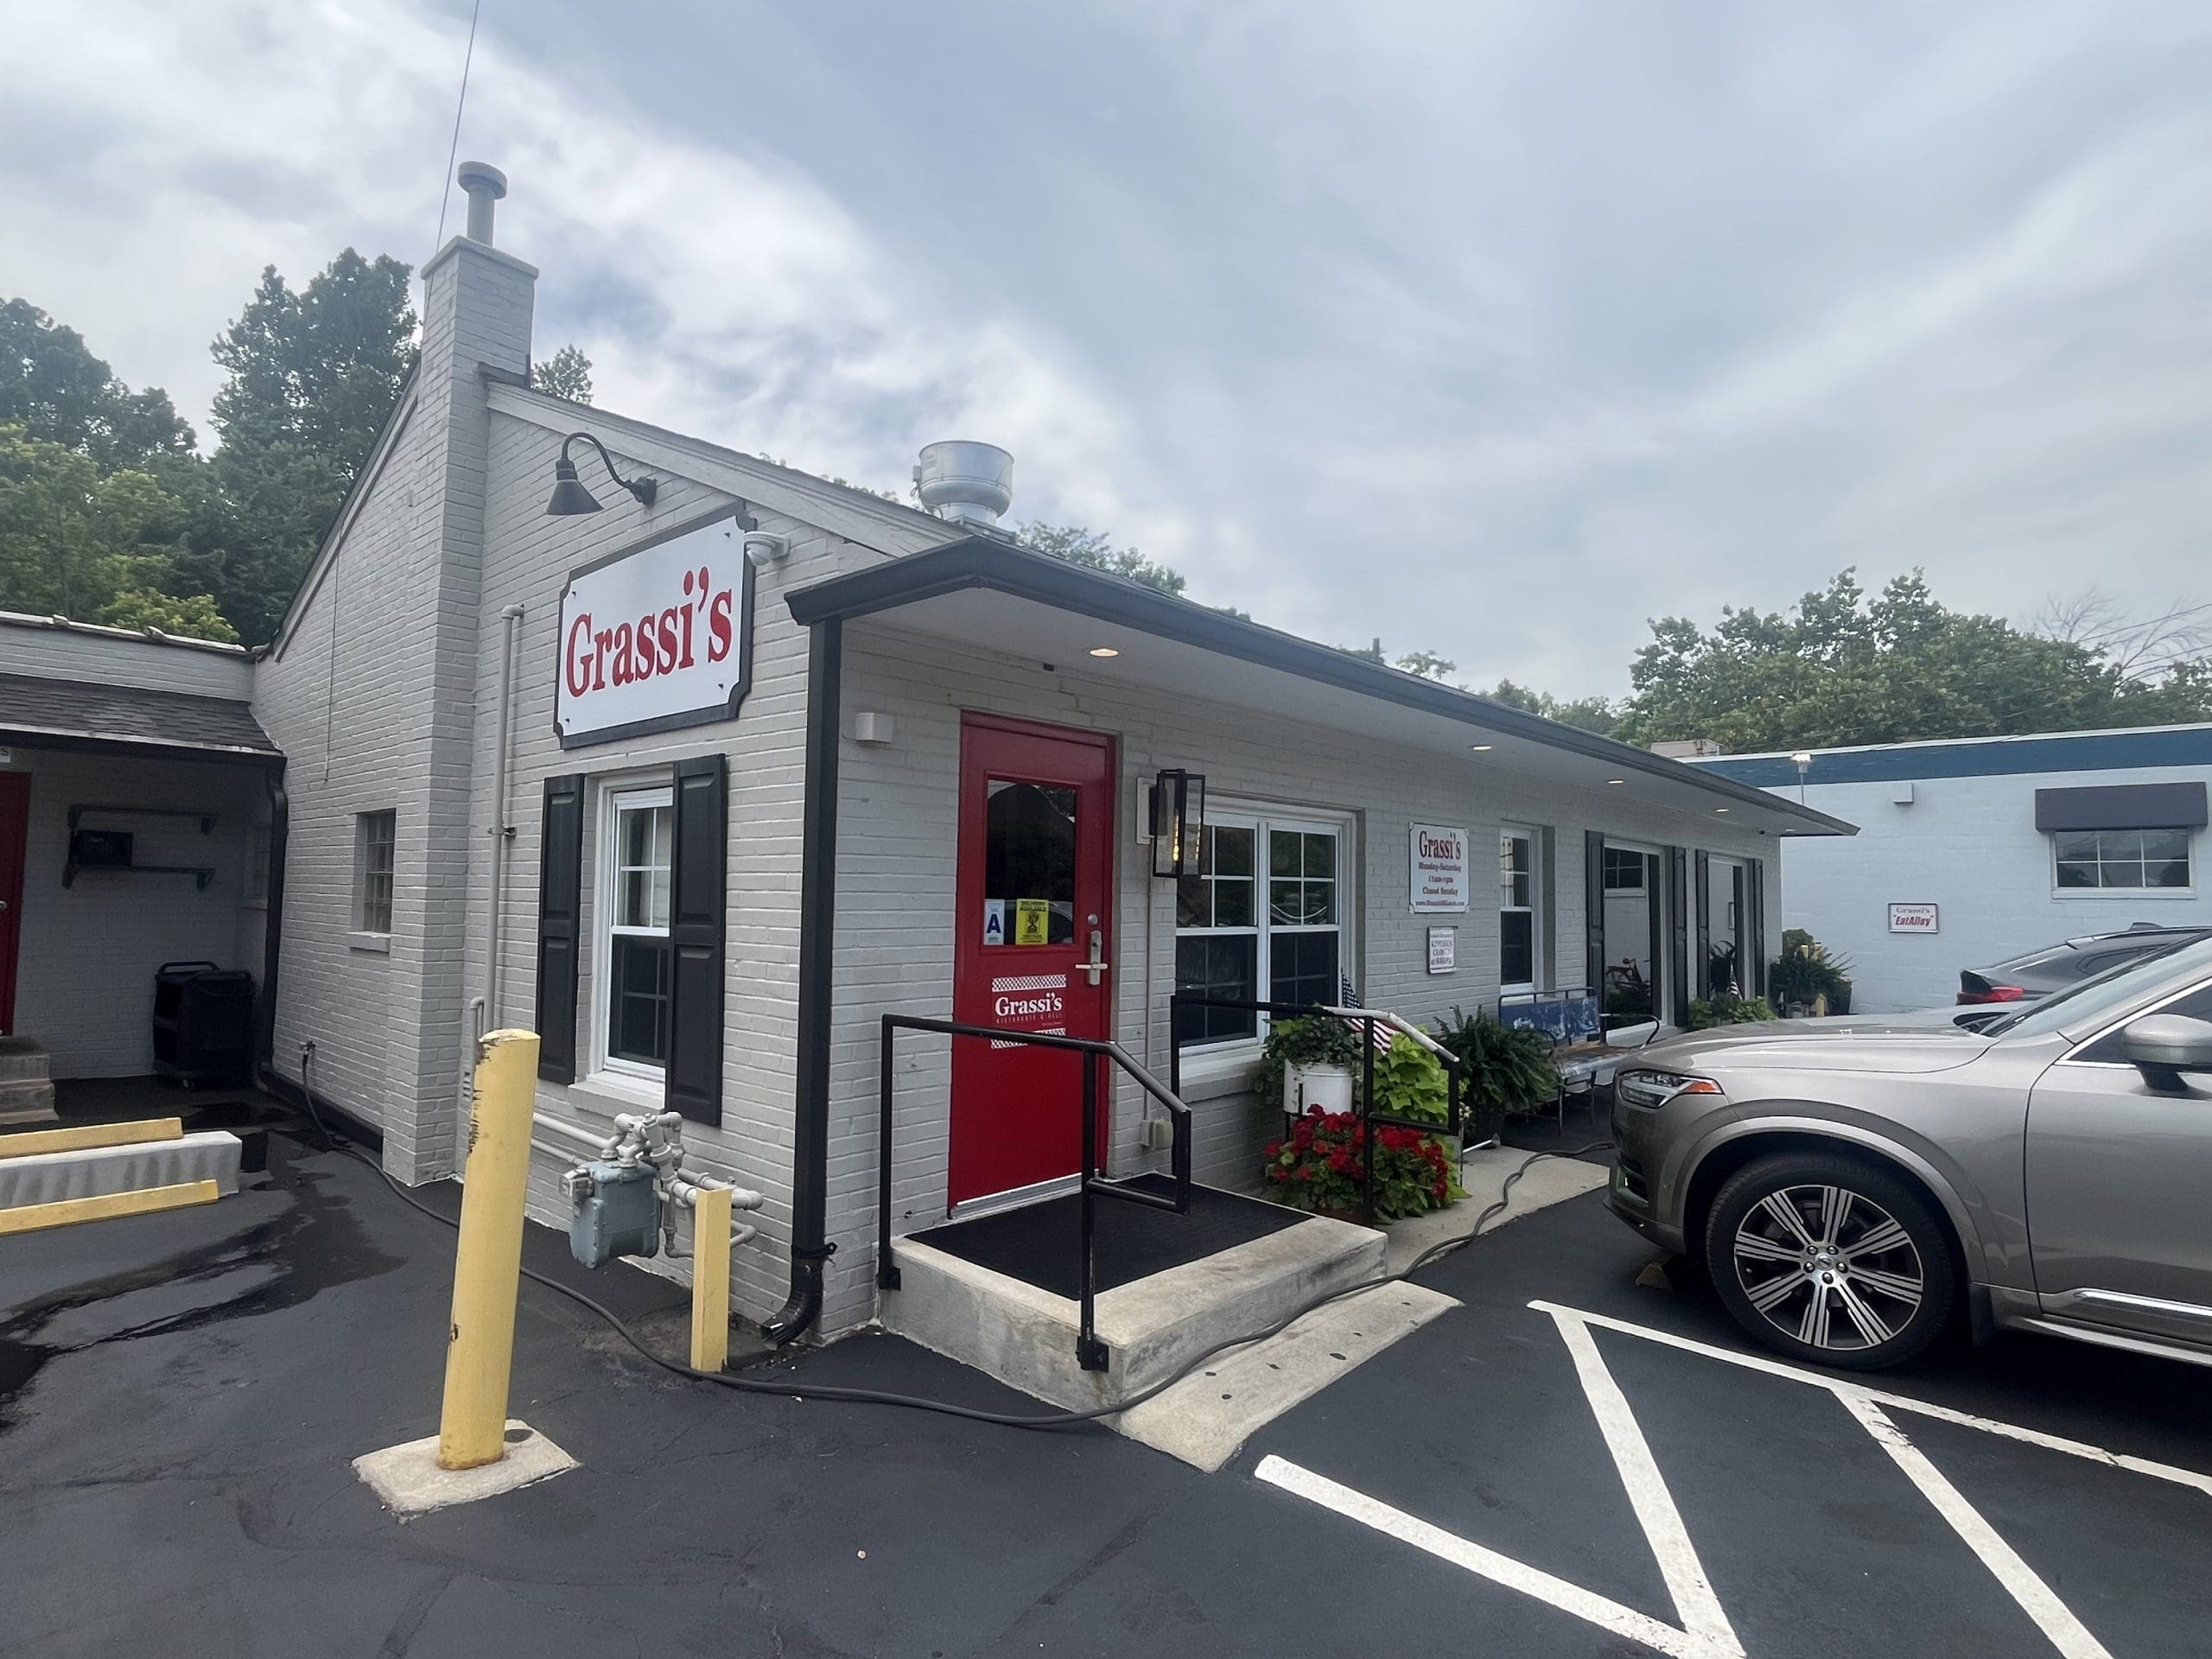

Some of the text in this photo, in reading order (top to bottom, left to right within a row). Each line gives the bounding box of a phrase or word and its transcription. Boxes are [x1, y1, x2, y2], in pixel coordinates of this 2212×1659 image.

[566, 565, 733, 698] Grassi's
[1419, 830, 1461, 861] Grassi's
[986, 913, 1001, 934] A
[995, 993, 1063, 1016] Grassi's
